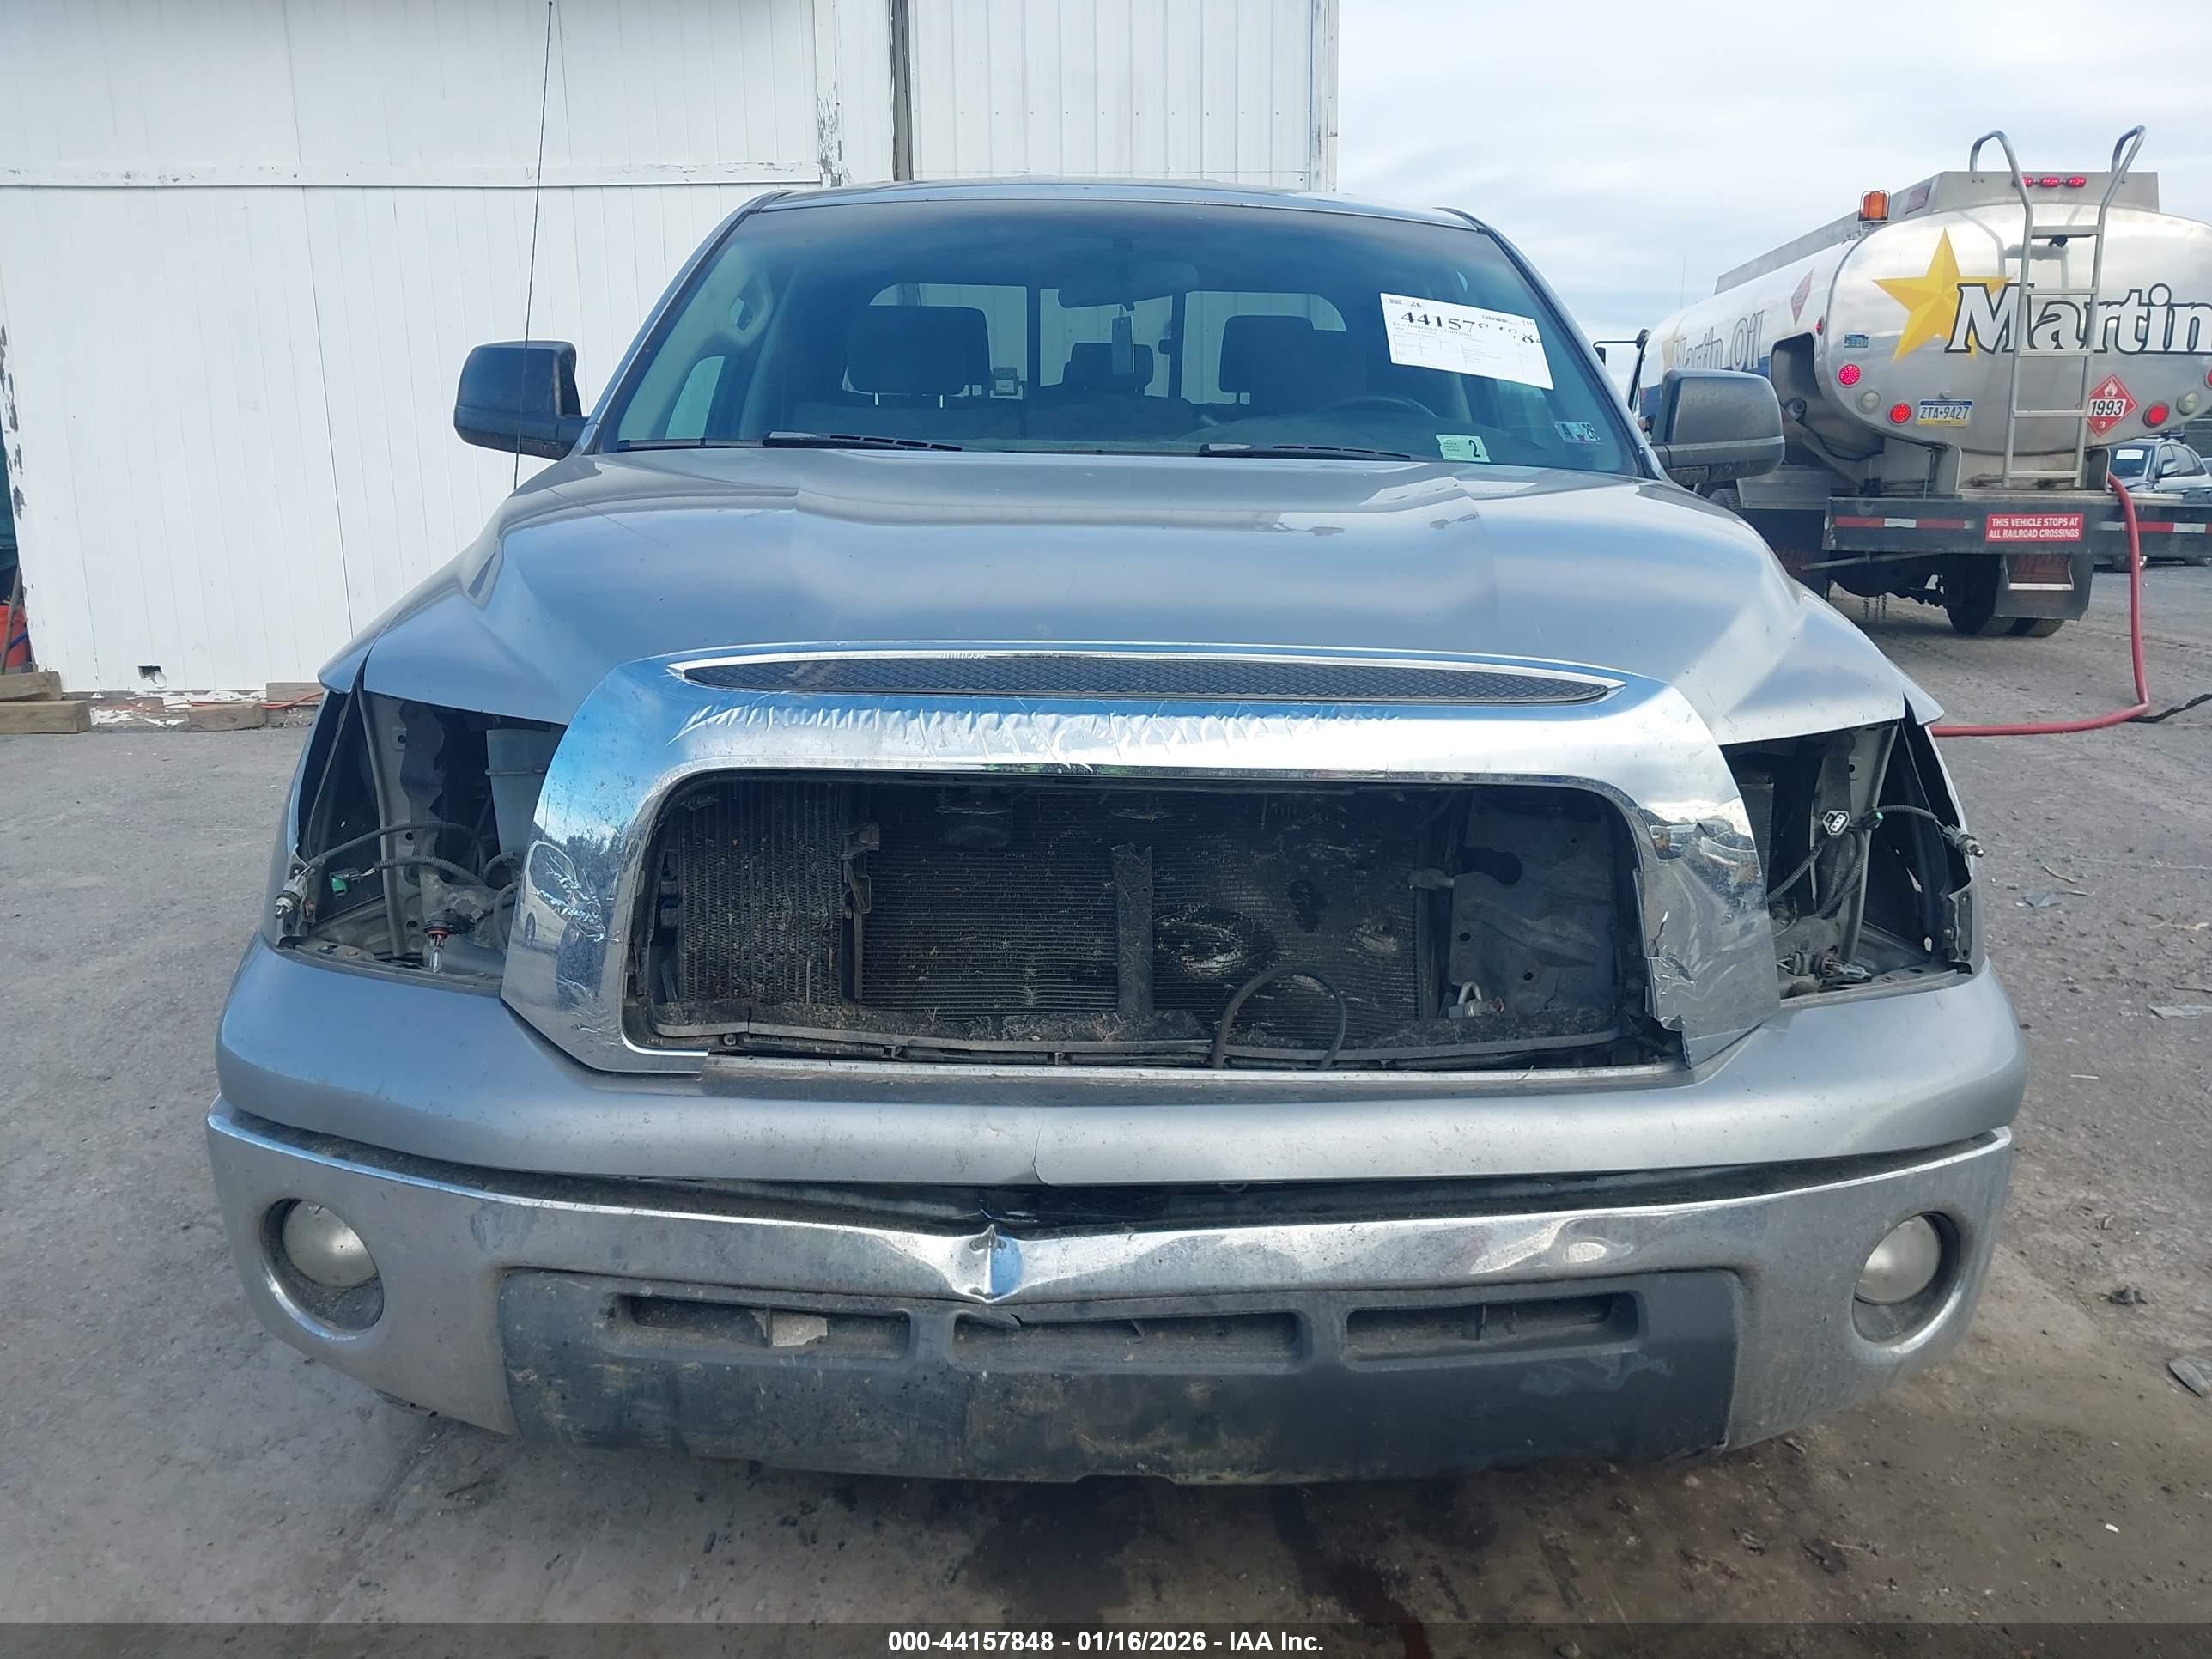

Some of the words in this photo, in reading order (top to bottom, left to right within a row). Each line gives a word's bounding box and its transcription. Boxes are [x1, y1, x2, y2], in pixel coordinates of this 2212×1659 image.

[1944, 283, 2212, 355] Martin
[2090, 399, 2124, 416] 1993
[2098, 420, 2107, 429] 3
[1468, 439, 1481, 458] 2
[1992, 518, 2009, 527] THIS
[2010, 517, 2042, 527] VEHICLE
[2043, 517, 2068, 527] STOPS
[2069, 516, 2079, 526] AT
[1988, 529, 2002, 538] ALL
[2002, 528, 2039, 538] RAILROAD
[2039, 528, 2080, 538] CROSSINGS
